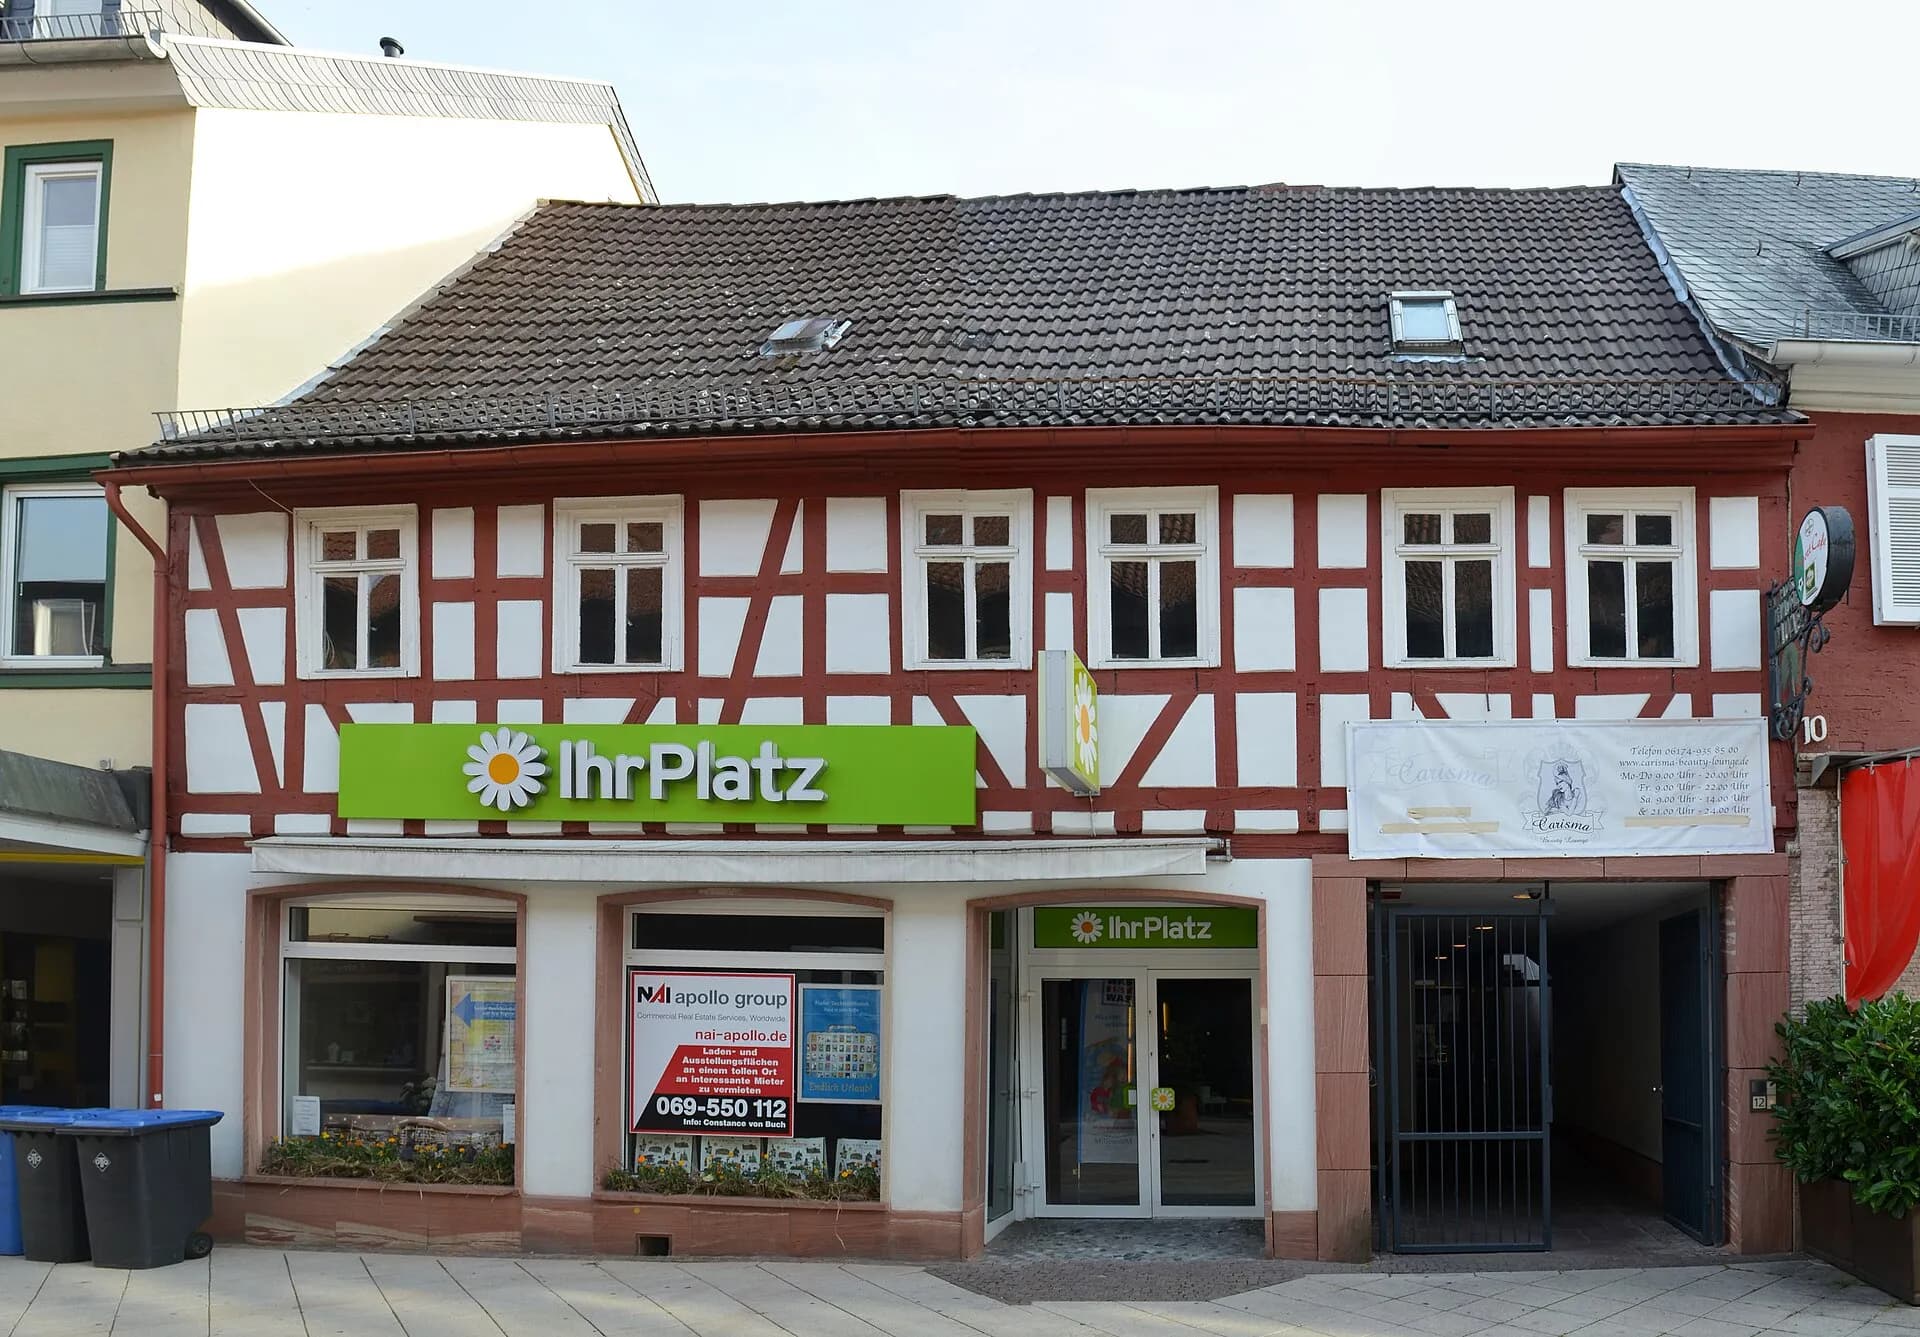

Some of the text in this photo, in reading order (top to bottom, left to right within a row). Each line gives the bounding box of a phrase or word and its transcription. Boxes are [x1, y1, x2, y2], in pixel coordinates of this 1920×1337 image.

[1801, 715, 1828, 745] 10
[1631, 745, 1662, 758] Telefon
[1664, 748, 1711, 756] 06174-935
[1714, 746, 1725, 754] 85
[1619, 755, 1749, 770] www.carisma-beauty-lounge.de
[1620, 771, 1652, 780] Mo-Do
[1655, 772, 1674, 781] 9.00
[1676, 769, 1695, 779] Uhr
[1704, 771, 1728, 779] 20.00
[1730, 769, 1749, 779] Uhr
[1655, 784, 1674, 793] 9.00
[1676, 781, 1695, 791] Uhr
[1704, 783, 1728, 791] 22.00
[1730, 781, 1750, 790] Uhr
[1656, 796, 1675, 805] 9.00
[1677, 793, 1696, 803] Uhr
[1705, 795, 1729, 803] 14.00
[1731, 792, 1750, 802] Uhr
[1638, 807, 1647, 816] &
[1650, 808, 1674, 816] 21.00
[1676, 805, 1695, 815] Uhr
[1703, 807, 1729, 815] 24.00
[1731, 804, 1751, 814] Uhr
[1532, 815, 1592, 832] Carisma
[637, 983, 788, 1008] NAI apollo group
[637, 1012, 786, 1023] Commercial Real Estate Services, Worldwide
[695, 1029, 788, 1043] nai-apollo.de
[702, 1047, 758, 1056] Laden- und
[682, 1056, 779, 1067] Ausstellungsflächen
[698, 1066, 728, 1075] einem
[731, 1067, 759, 1076] tollen
[761, 1067, 778, 1076] Ort
[691, 1075, 751, 1085] interessante
[754, 1077, 785, 1086] Mieter
[713, 1085, 762, 1095] vermieten
[656, 1096, 787, 1119] 069-550 112
[1754, 1097, 1765, 1107] 12
[683, 1118, 702, 1126] Info:
[703, 1119, 746, 1127] Constance
[765, 1120, 787, 1129] Buch
